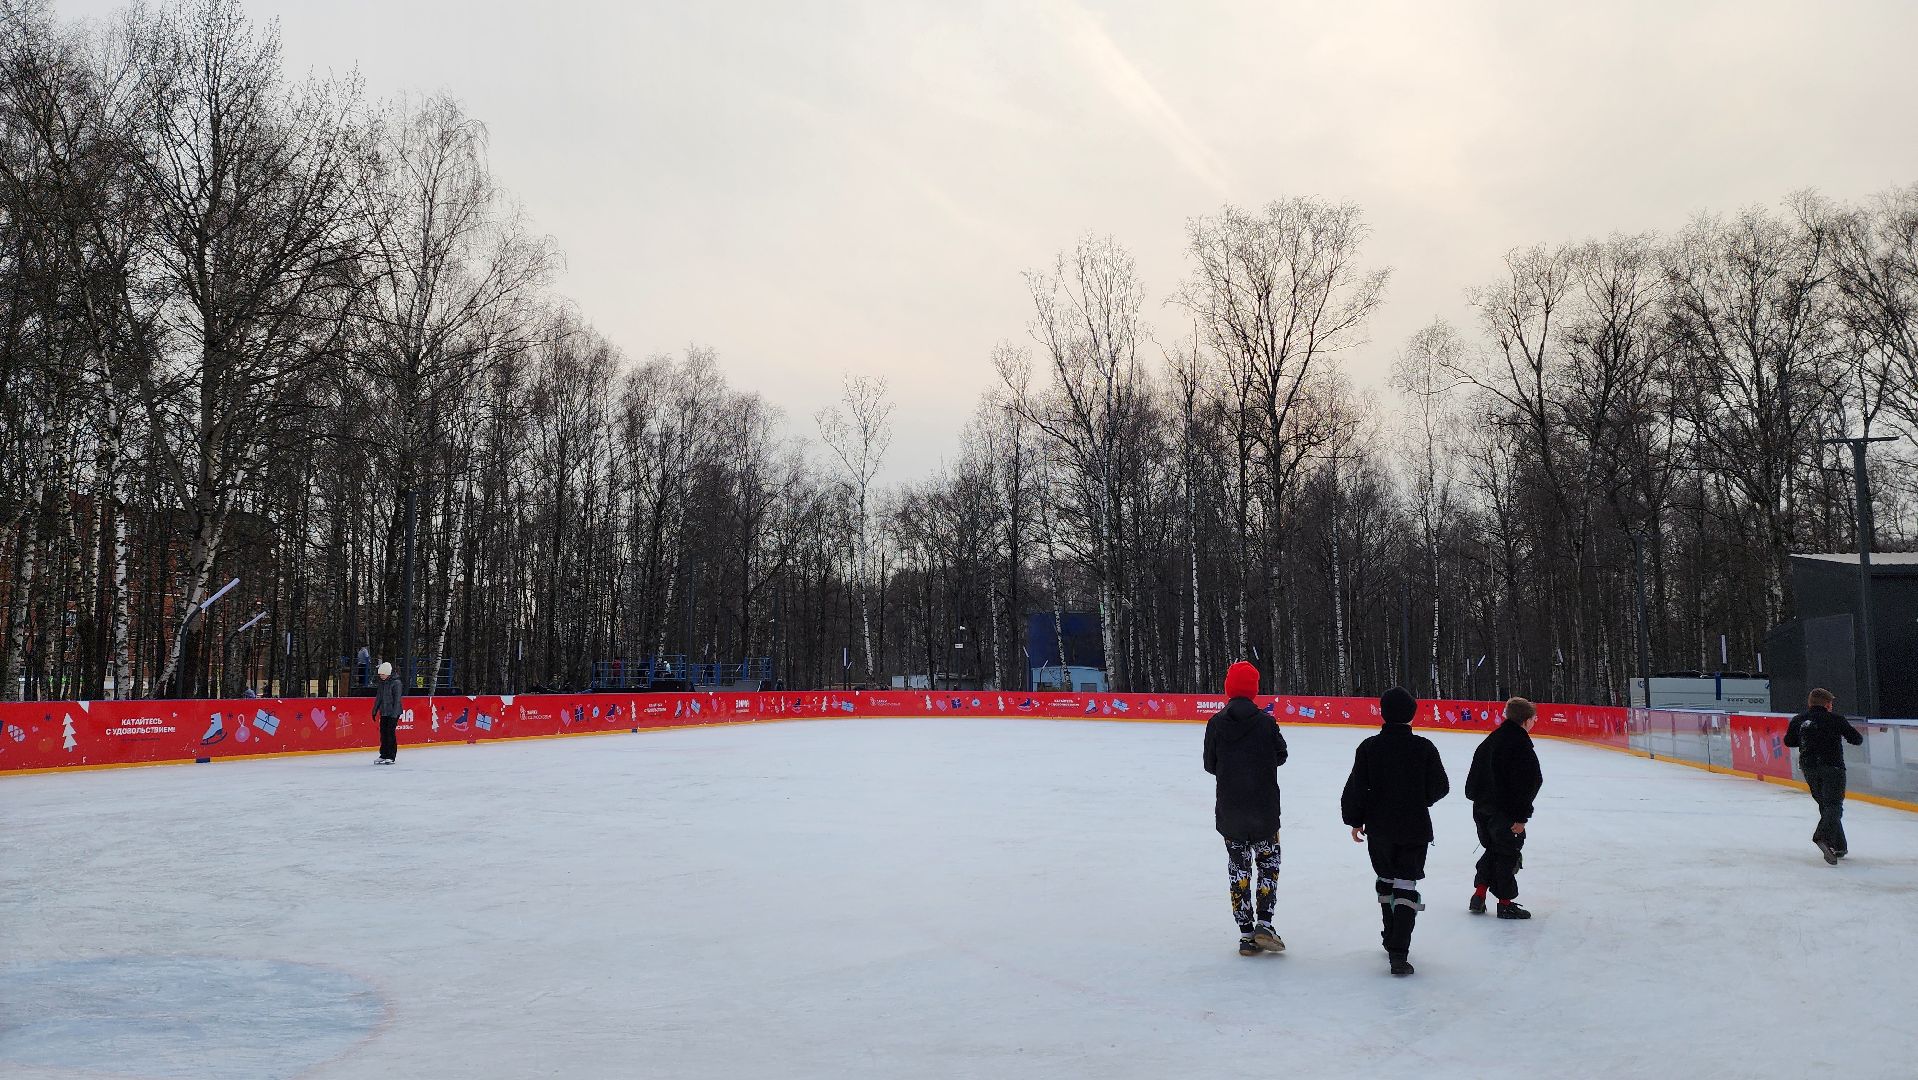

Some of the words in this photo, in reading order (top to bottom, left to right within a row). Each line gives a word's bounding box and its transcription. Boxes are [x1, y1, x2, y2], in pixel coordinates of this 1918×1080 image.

[1196, 701, 1226, 709] ЗИМА
[121, 717, 163, 726] КАТАЙТЕСЬ
[105, 728, 112, 736] С
[112, 726, 176, 736] УДОВОЛЬСТВИЕМ!
